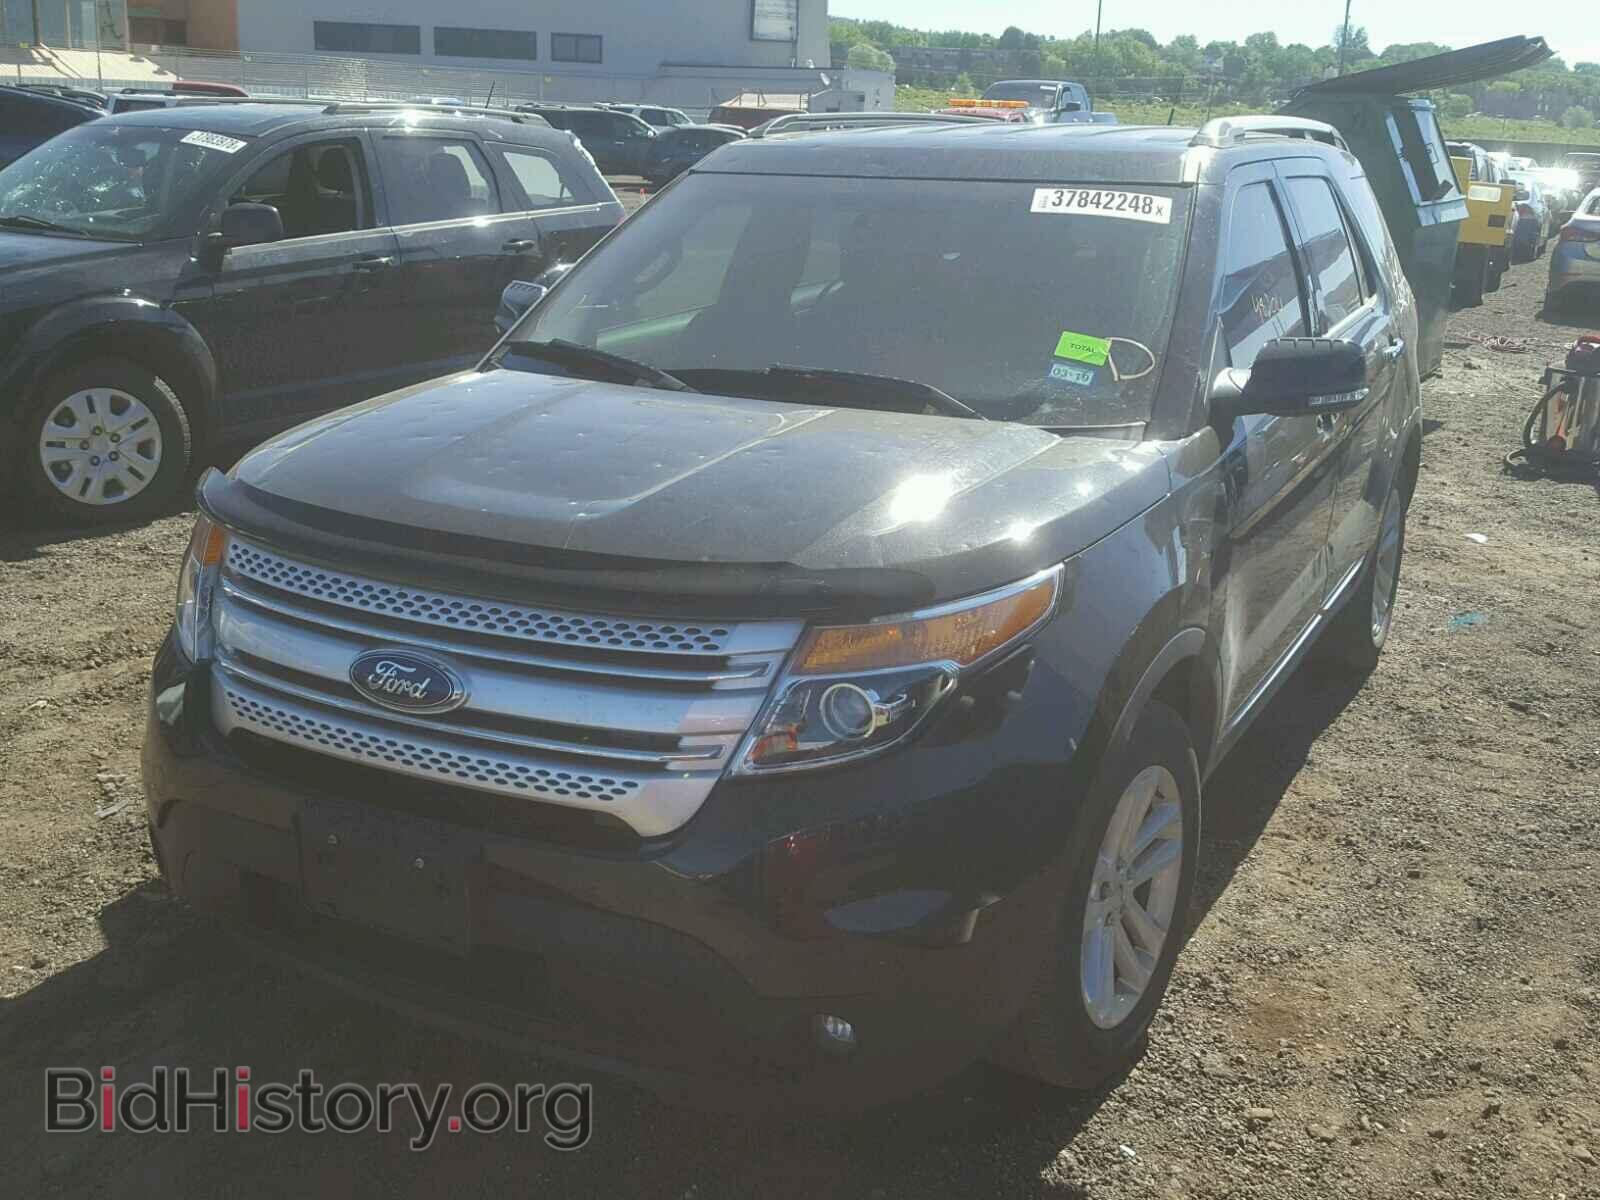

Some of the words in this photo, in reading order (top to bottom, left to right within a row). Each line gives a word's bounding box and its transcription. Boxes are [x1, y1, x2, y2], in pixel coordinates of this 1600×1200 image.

[1051, 189, 1153, 214] 37842248
[1070, 343, 1097, 354] TOTAL
[368, 660, 432, 699] Ford
